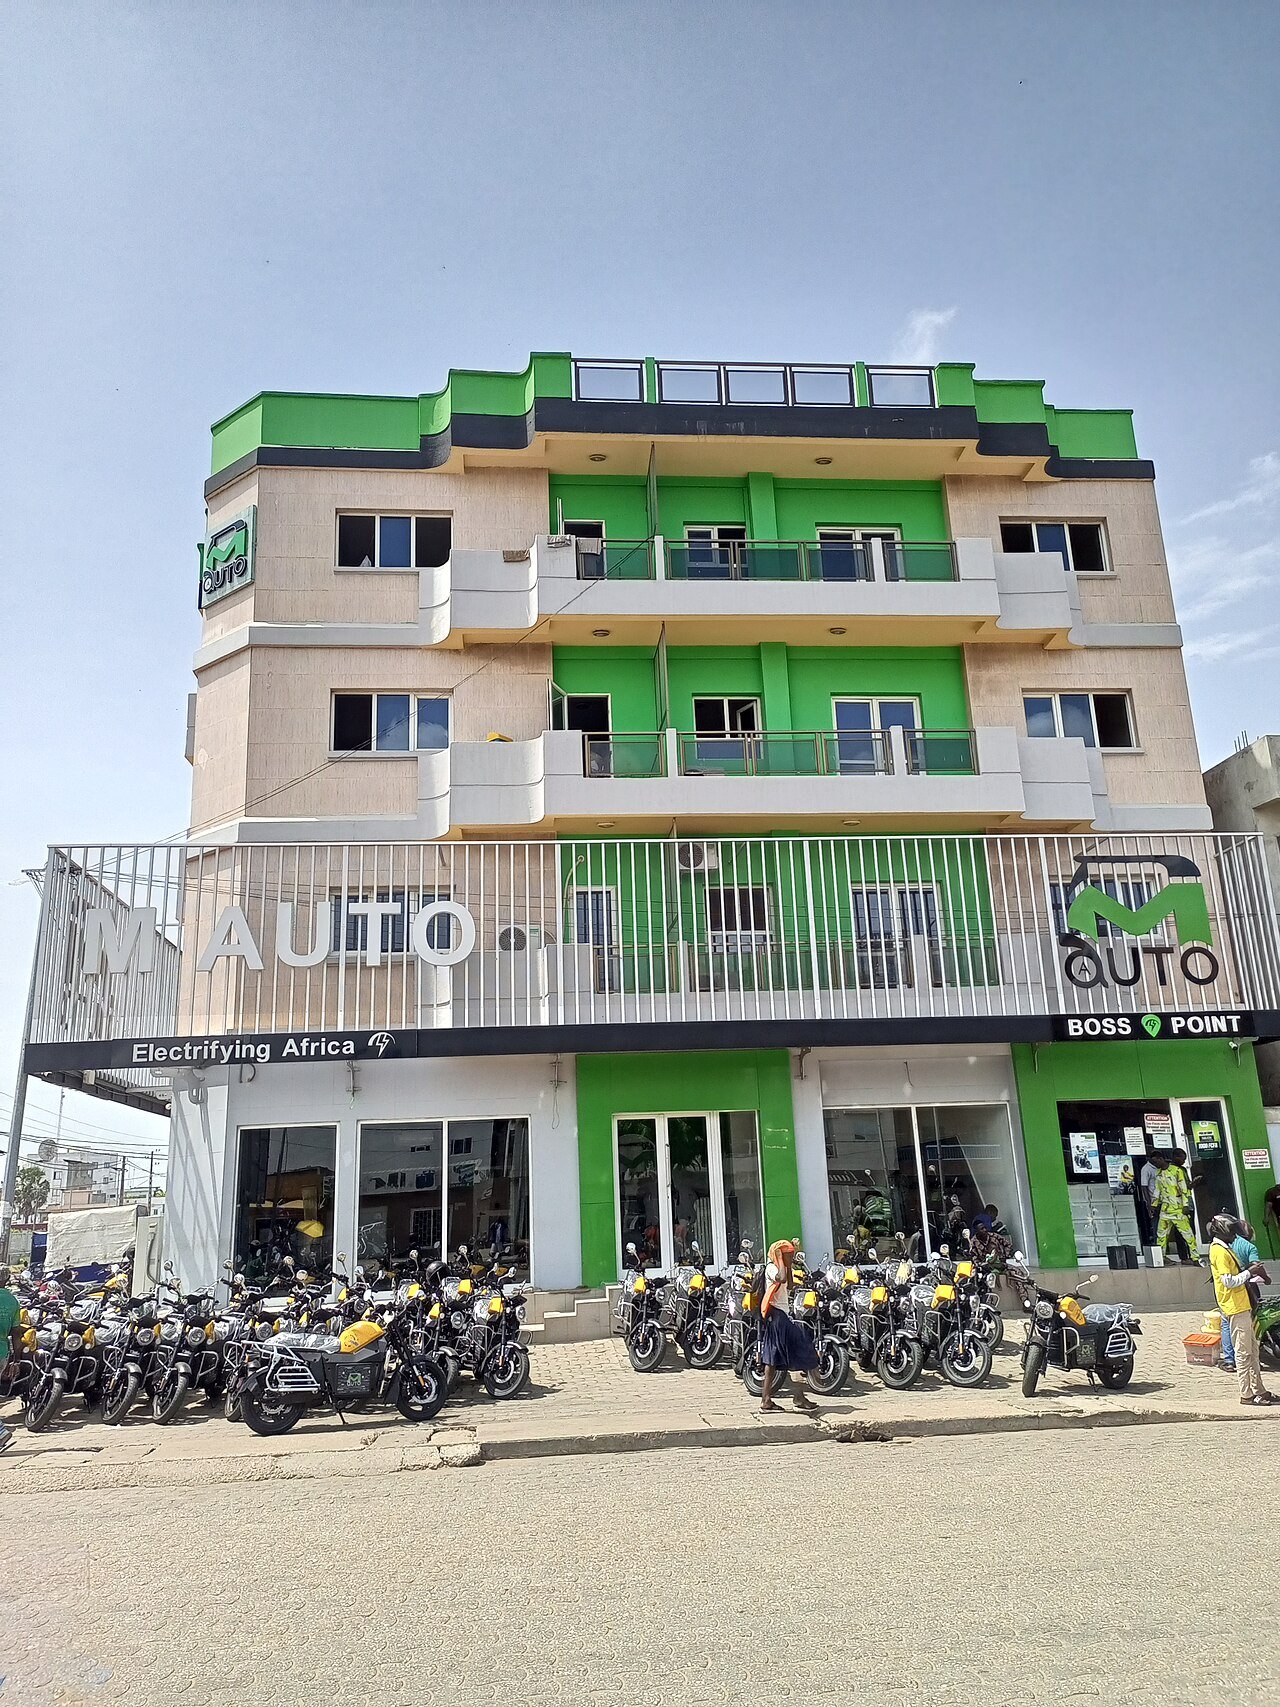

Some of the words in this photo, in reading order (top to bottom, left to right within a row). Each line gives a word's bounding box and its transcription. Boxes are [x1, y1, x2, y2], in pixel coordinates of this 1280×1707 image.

[196, 900, 476, 972] AUTO
[1067, 1018, 1132, 1036] BOSS
[1170, 1015, 1241, 1033] POINT
[132, 1040, 271, 1064] Electrifying
[282, 1037, 355, 1057] Africa
